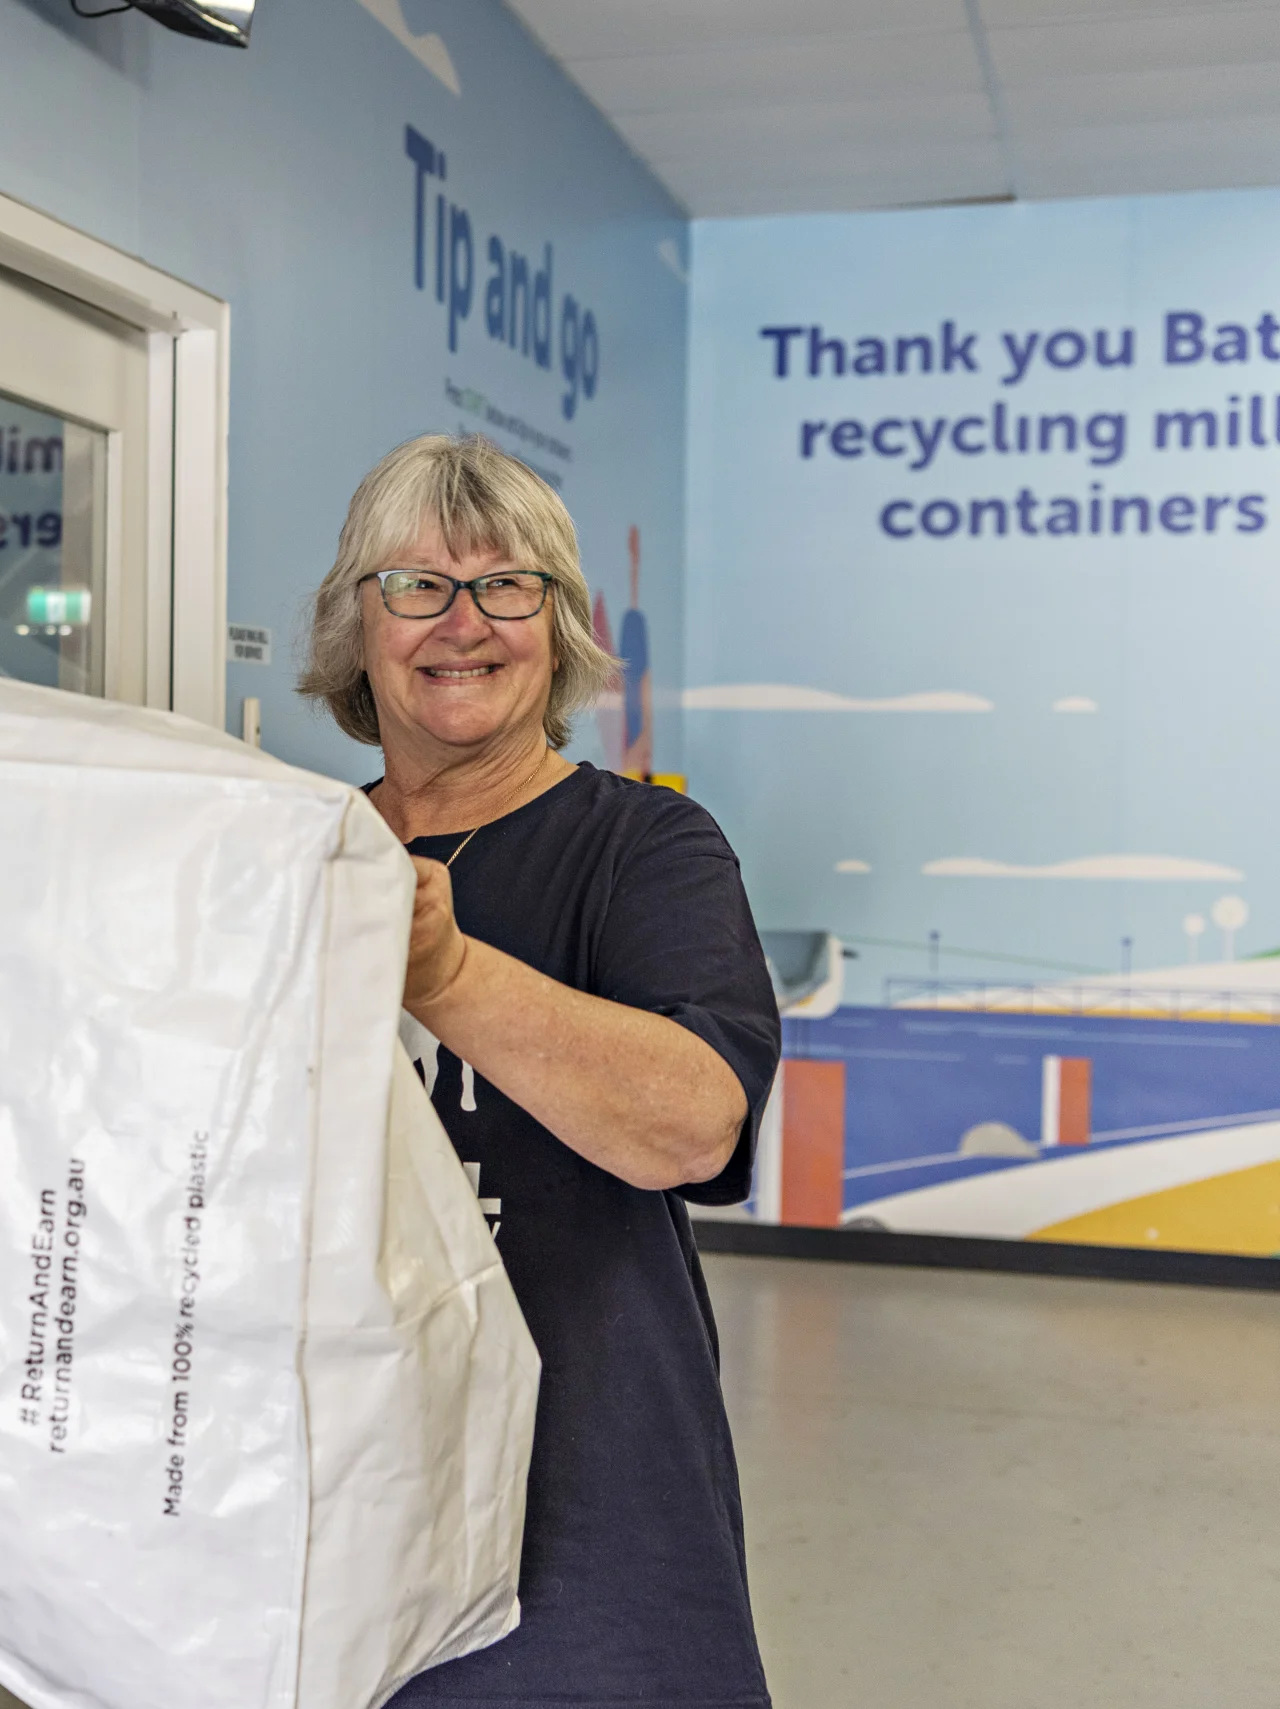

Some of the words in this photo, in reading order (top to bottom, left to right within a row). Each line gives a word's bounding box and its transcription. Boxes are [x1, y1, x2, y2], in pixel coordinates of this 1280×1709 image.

[404, 122, 474, 355] Tip
[484, 234, 553, 371] and
[560, 294, 600, 423] go
[759, 320, 978, 379] Thank
[1001, 329, 1134, 387] you
[879, 483, 1269, 540] containers
[187, 1131, 209, 1209] plastic
[179, 1217, 201, 1318] recycled
[49, 1158, 87, 1453] returnandearn.org.au
[172, 1323, 195, 1382] 100%
[167, 1392, 188, 1446] from
[163, 1455, 184, 1516] Made
